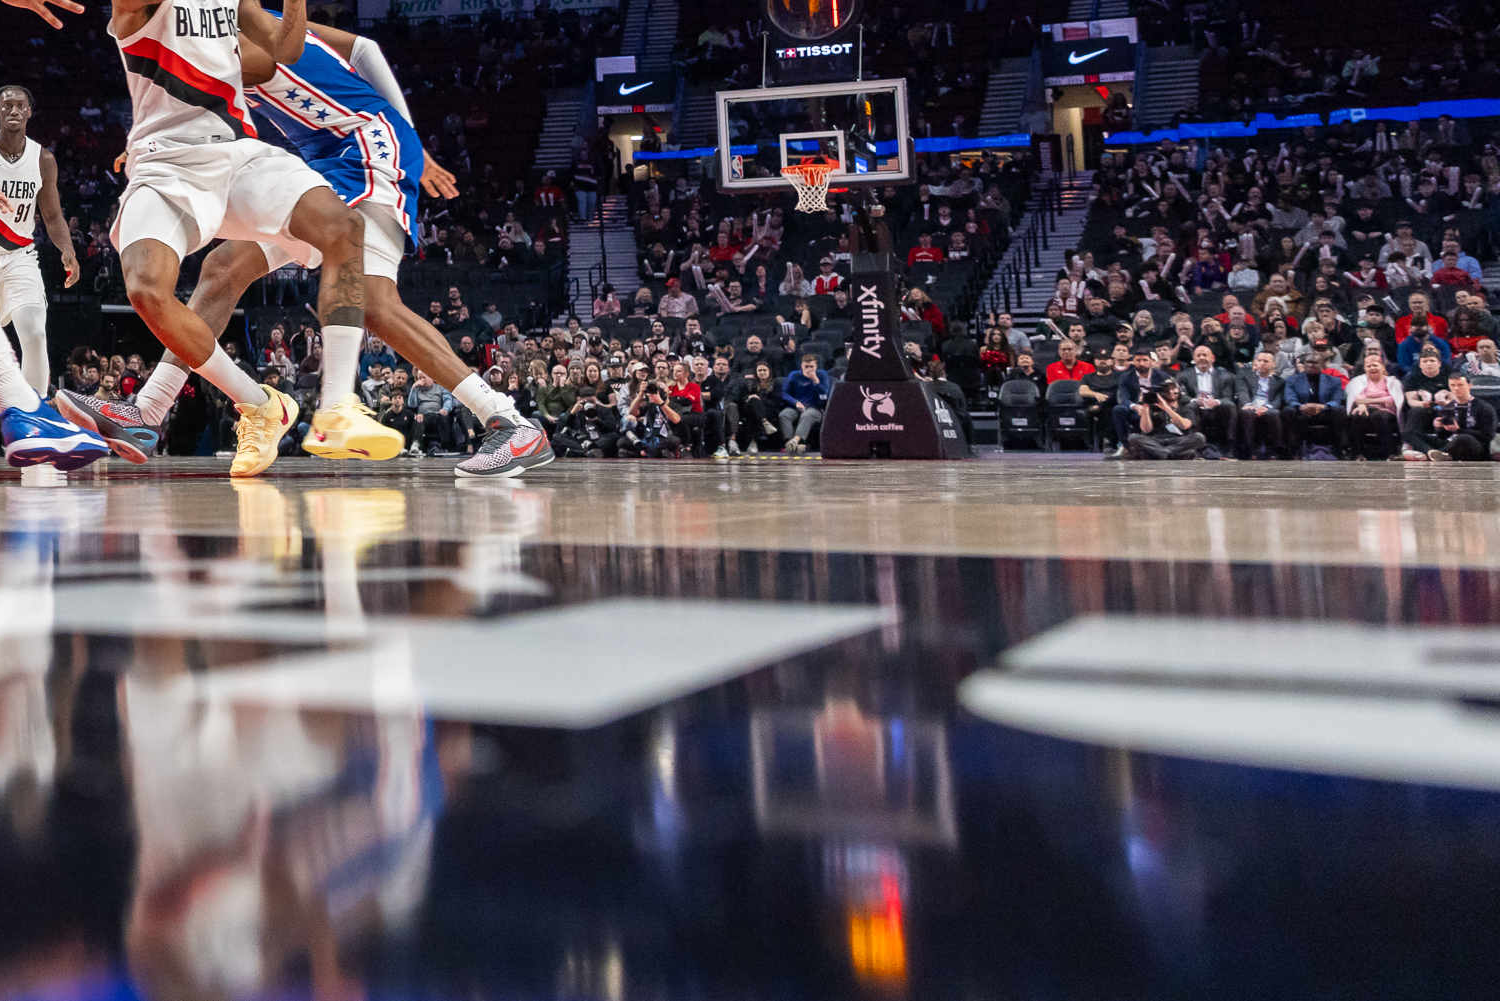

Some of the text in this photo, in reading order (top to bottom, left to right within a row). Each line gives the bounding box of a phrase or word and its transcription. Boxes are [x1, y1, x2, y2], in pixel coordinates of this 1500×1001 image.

[173, 6, 237, 38] BLAZER
[797, 43, 853, 58] TISSOT
[14, 203, 31, 223] 91
[857, 285, 885, 359] xfinity
